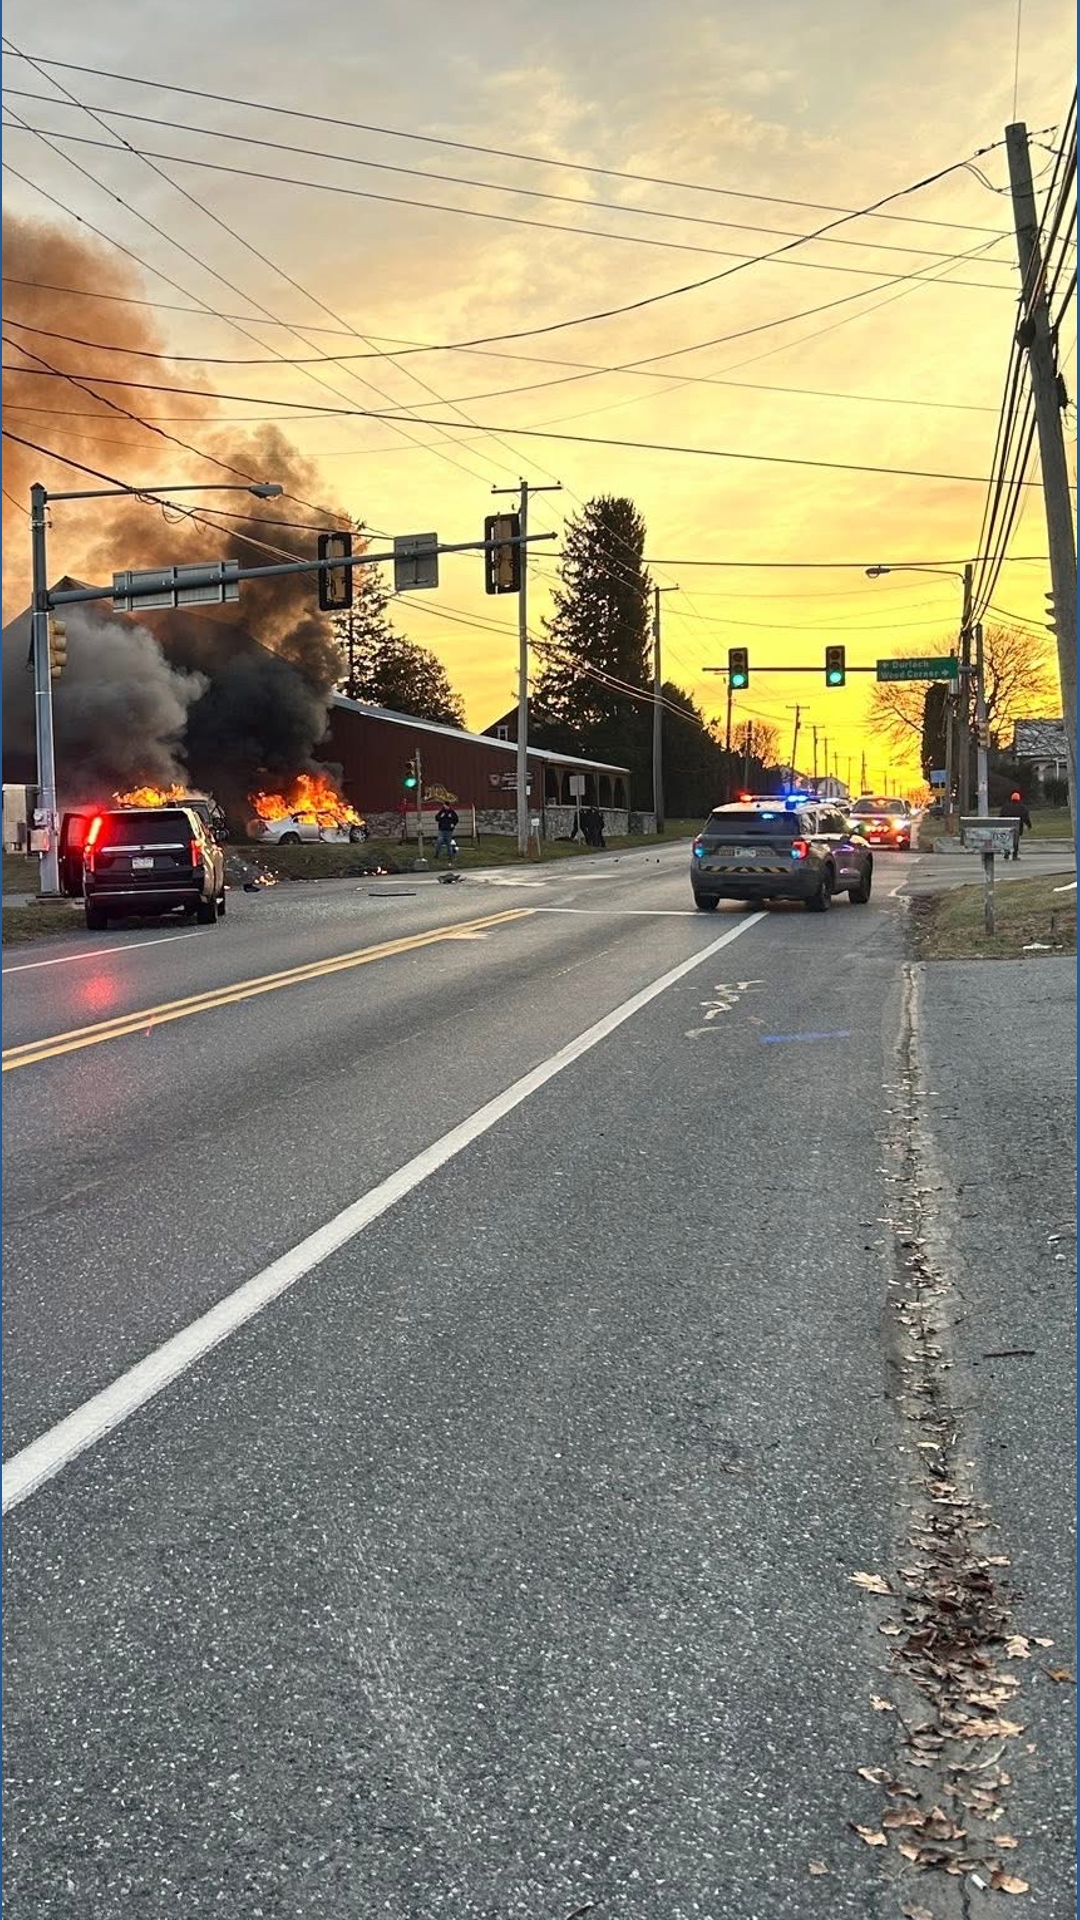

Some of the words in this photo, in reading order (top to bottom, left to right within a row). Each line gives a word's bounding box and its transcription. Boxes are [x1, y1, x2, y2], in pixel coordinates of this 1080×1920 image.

[892, 660, 929, 669] Durlach
[881, 671, 905, 679] Wood
[907, 670, 940, 678] Corner
